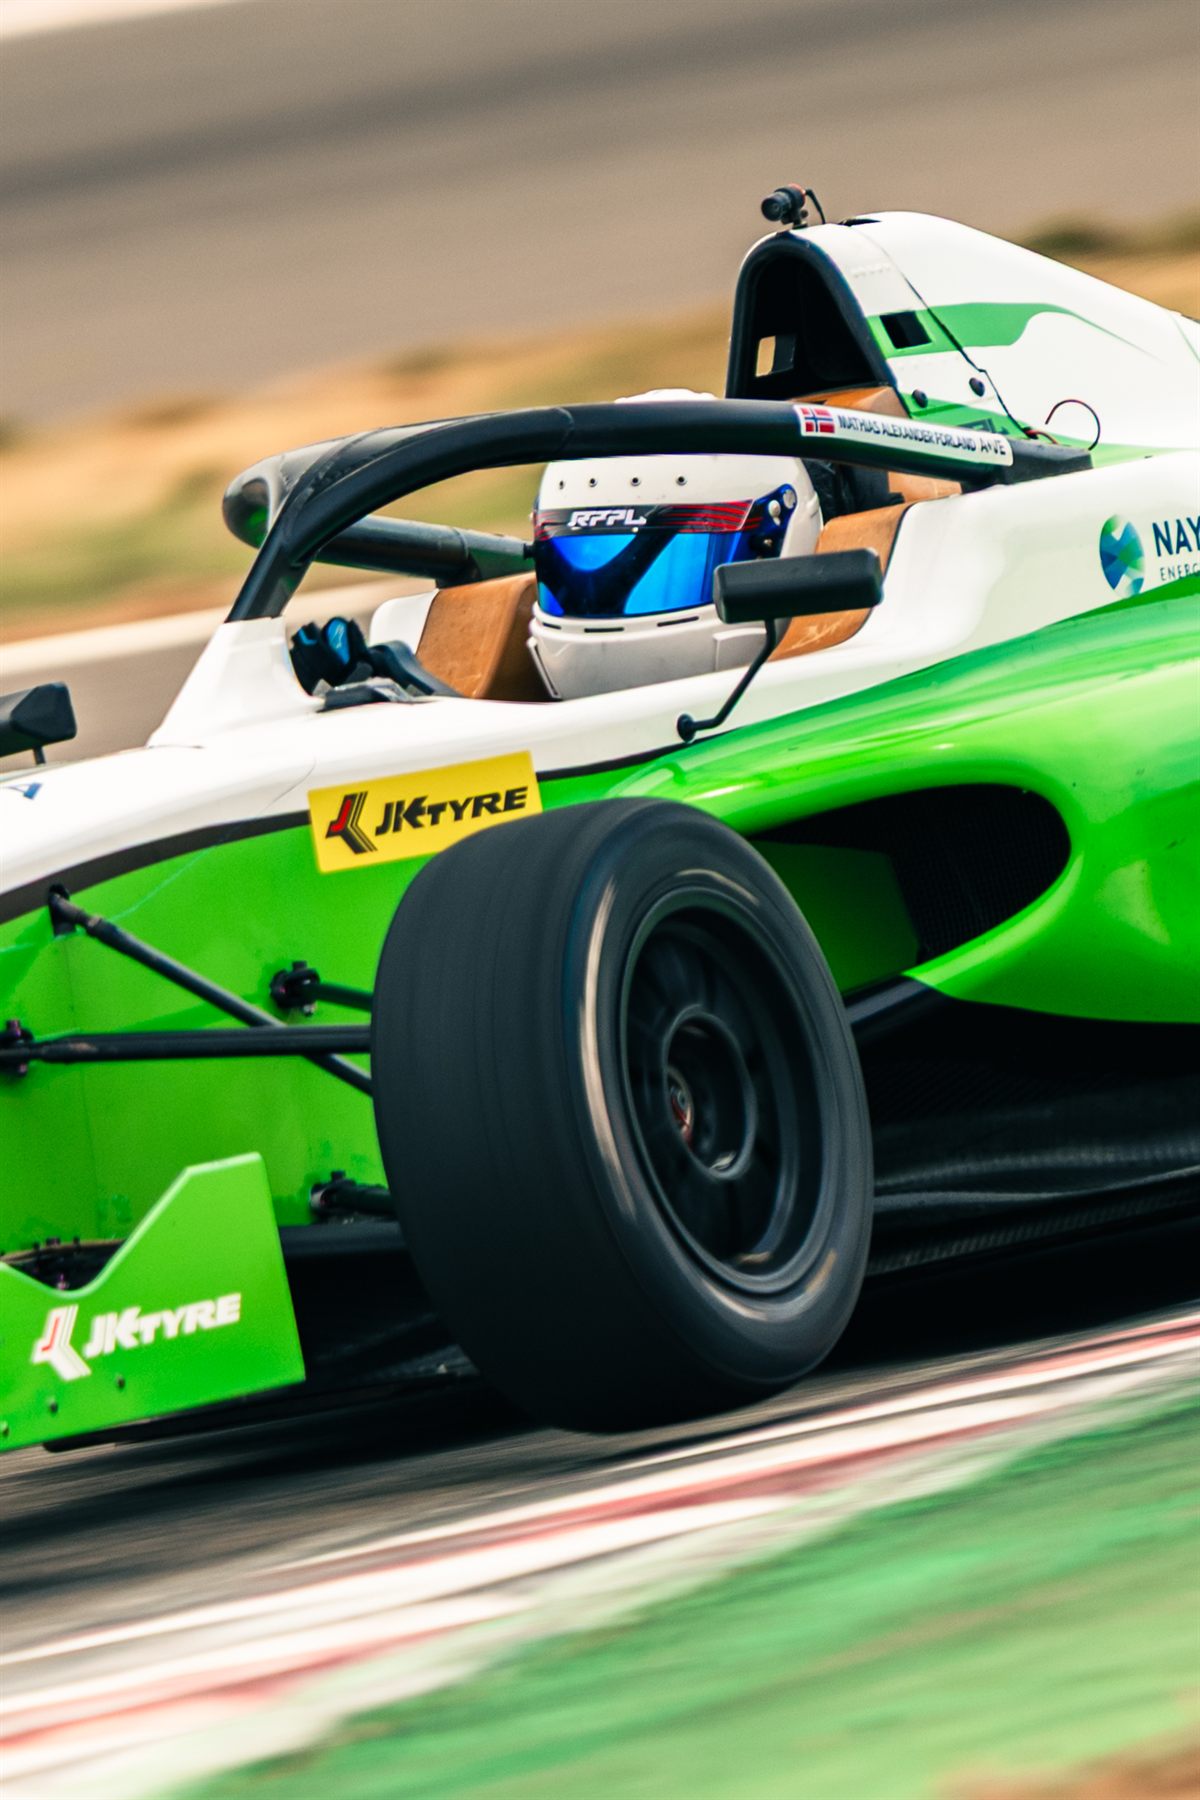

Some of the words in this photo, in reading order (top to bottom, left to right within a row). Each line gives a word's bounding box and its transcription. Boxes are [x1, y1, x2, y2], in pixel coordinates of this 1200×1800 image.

[838, 414, 881, 434] MATHIAS
[881, 422, 935, 444] ALEXANDER
[566, 509, 647, 527] RPPL
